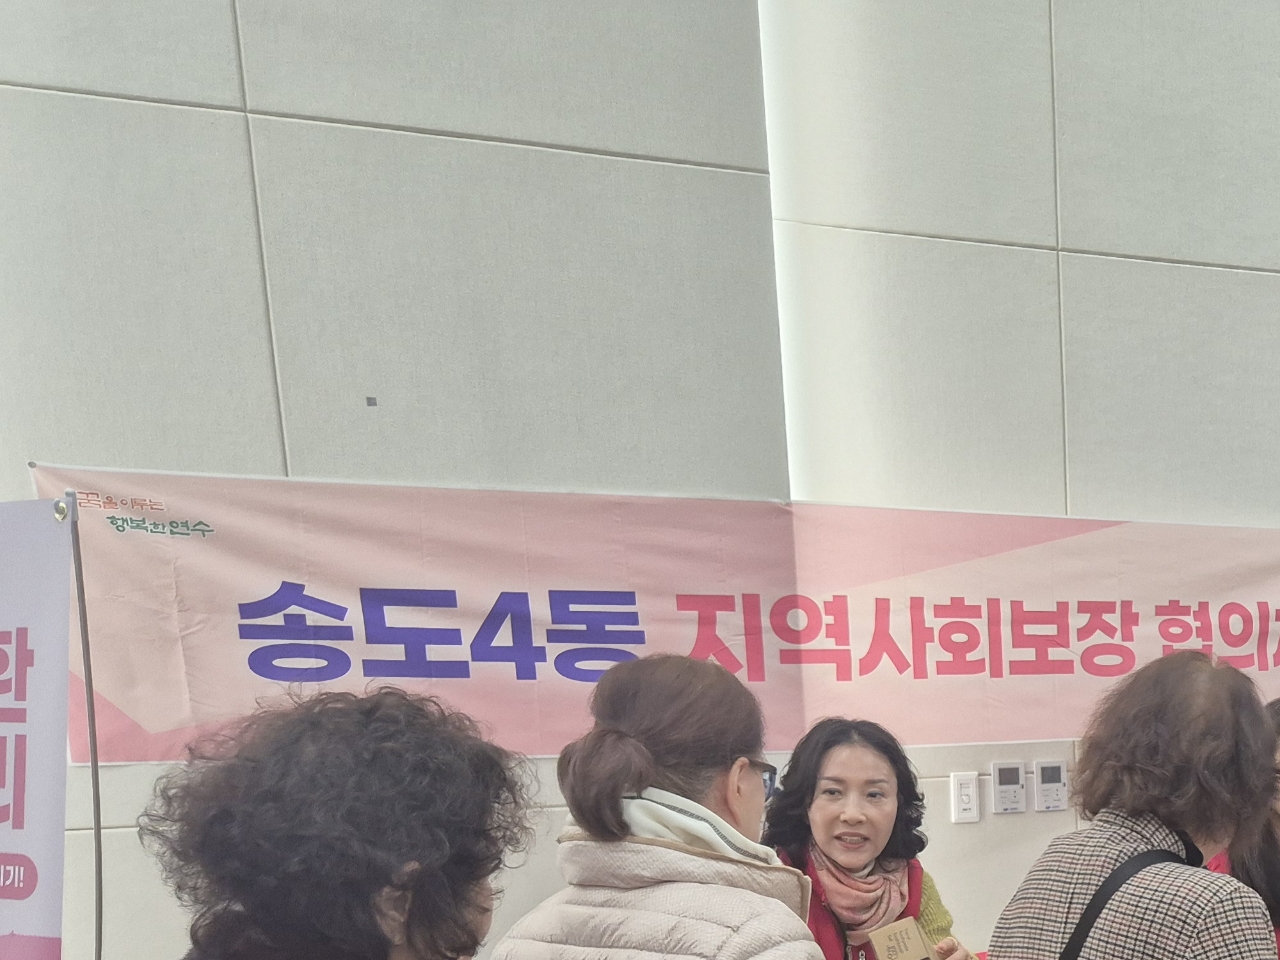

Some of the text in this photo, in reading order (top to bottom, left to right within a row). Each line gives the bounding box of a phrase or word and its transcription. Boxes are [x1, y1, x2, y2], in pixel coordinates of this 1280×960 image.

[106, 515, 215, 538] 행복한 연수
[238, 580, 646, 683] 송도4동
[675, 593, 1138, 683] 지역사회보장
